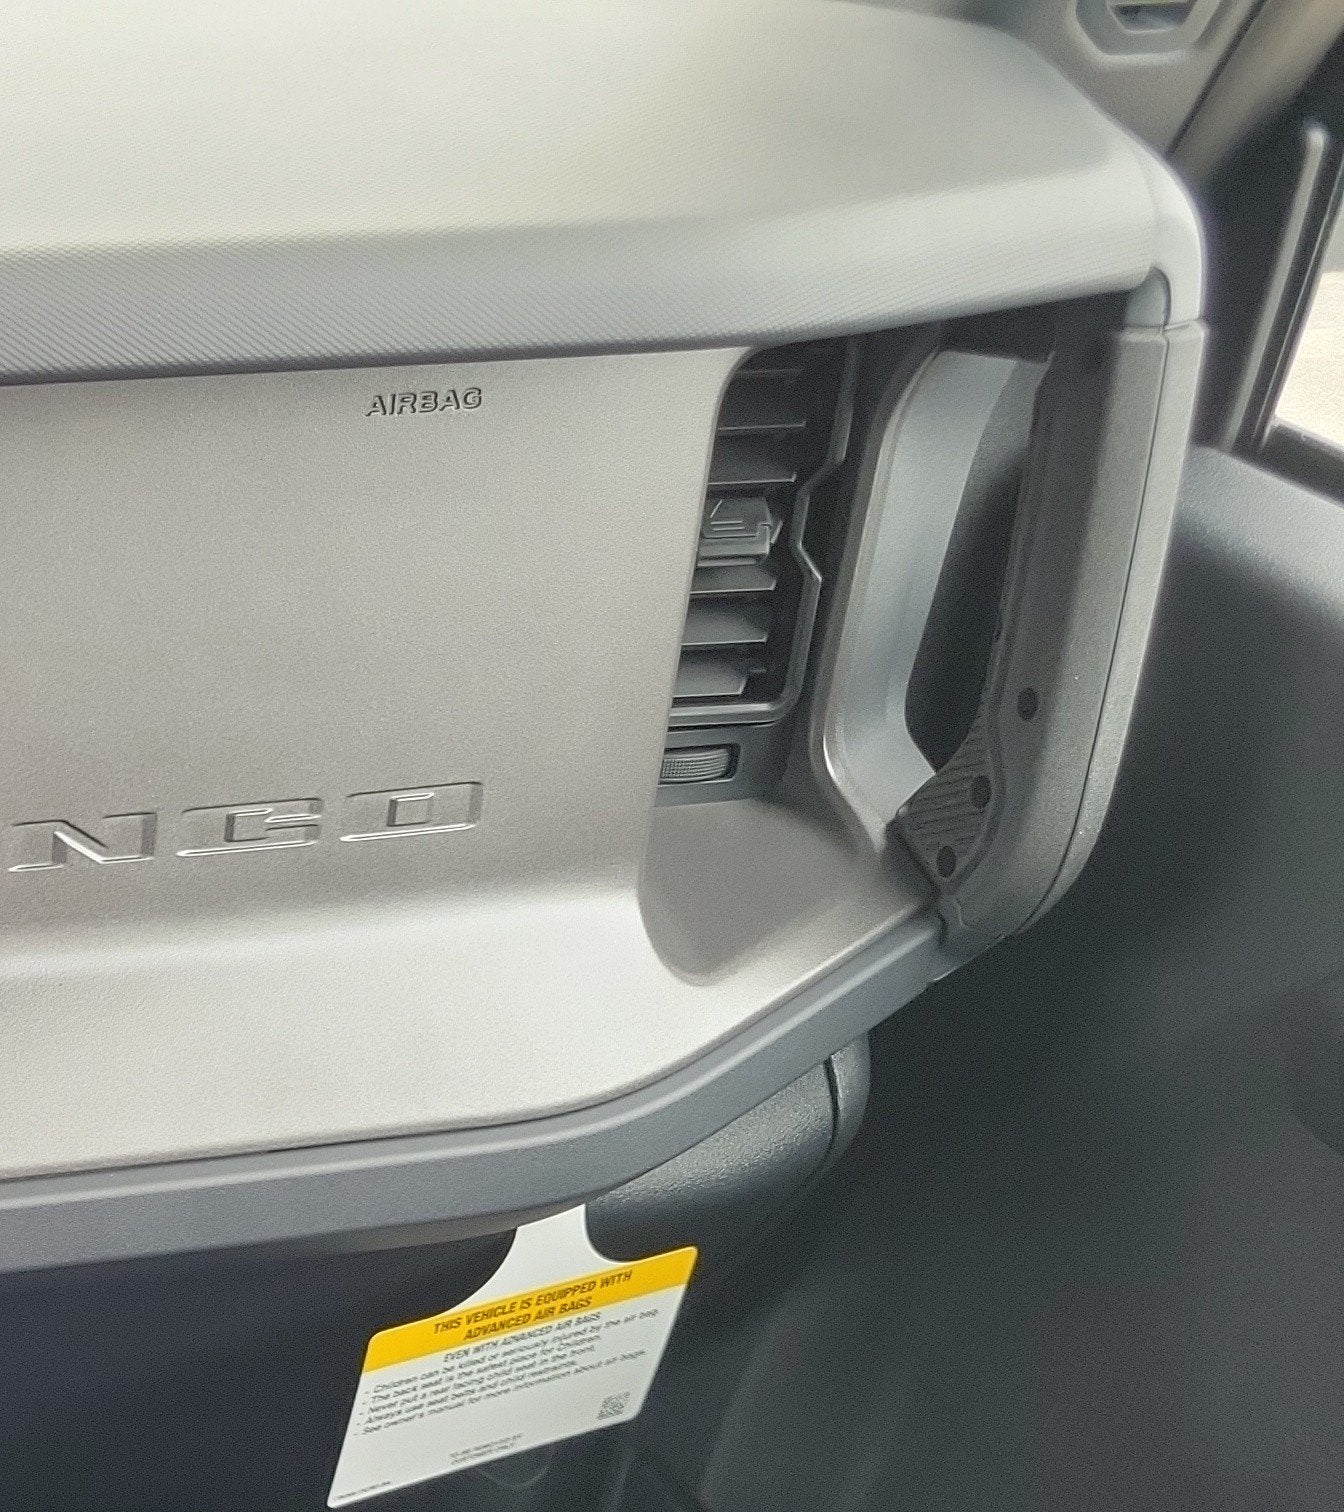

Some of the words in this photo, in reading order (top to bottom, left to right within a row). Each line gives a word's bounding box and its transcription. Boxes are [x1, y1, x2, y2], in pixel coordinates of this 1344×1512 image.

[365, 387, 483, 417] AIRBAG
[434, 1318, 462, 1334] THIS
[467, 1303, 517, 1325] VEHICLE
[521, 1299, 532, 1310] IS
[537, 1281, 597, 1306] EQUIPPED
[602, 1272, 632, 1288] WITH
[466, 1314, 531, 1340] ADVANCED
[536, 1308, 556, 1321] AIR
[561, 1298, 592, 1314] BAGS
